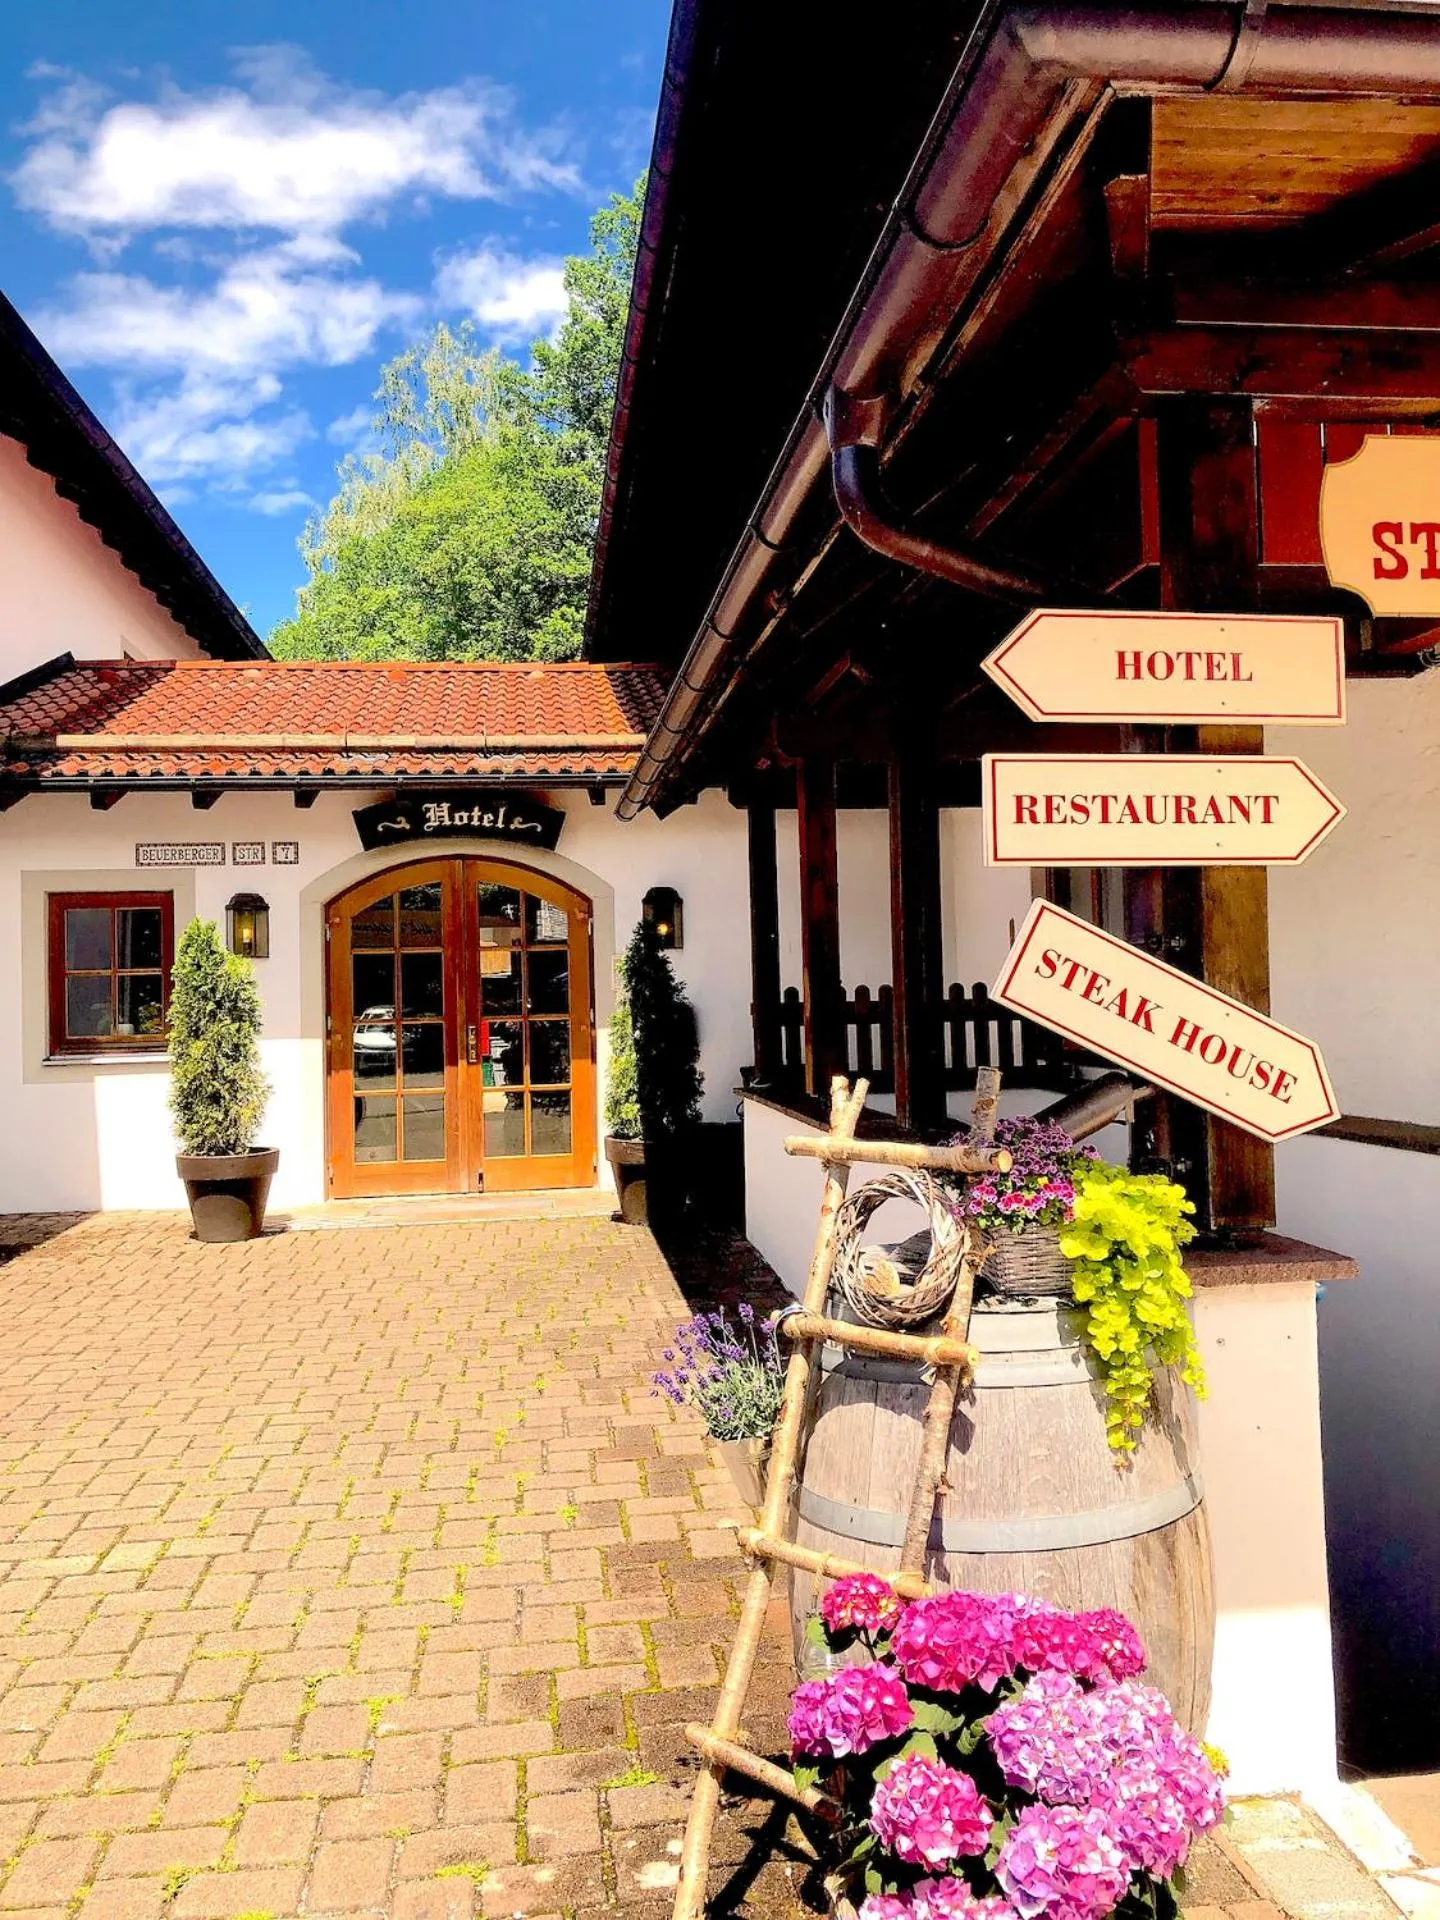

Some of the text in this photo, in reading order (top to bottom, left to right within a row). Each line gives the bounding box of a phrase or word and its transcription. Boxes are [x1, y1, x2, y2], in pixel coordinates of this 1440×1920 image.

[1372, 521, 1440, 580] ST
[1115, 650, 1254, 682] HOTEL
[422, 802, 506, 831] Hotel
[1013, 794, 1280, 826] RESTAURANT
[141, 846, 290, 862] BEUERBERGER STR 7
[1033, 948, 1299, 1105] STEAK HOUSE
